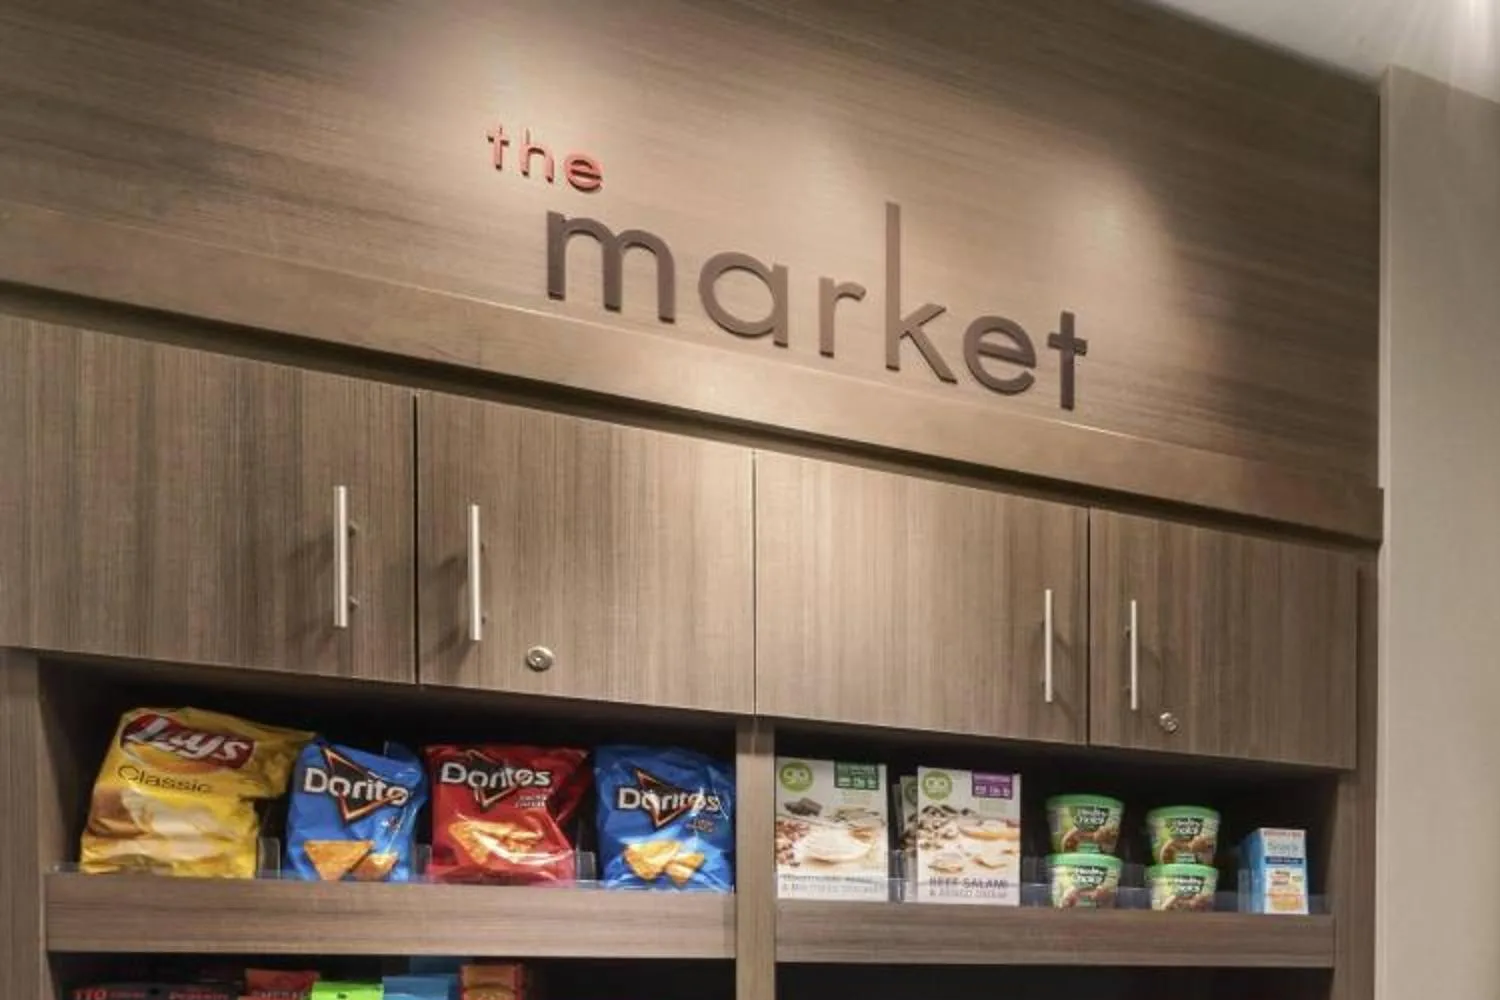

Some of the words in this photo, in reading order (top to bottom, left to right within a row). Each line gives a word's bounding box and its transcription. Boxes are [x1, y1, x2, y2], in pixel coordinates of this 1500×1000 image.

[487, 124, 603, 193] the
[546, 201, 1088, 411] market
[117, 763, 213, 794] Classic
[304, 767, 411, 806] Dorito
[440, 761, 552, 790] Doritos
[618, 787, 721, 813] Doritos
